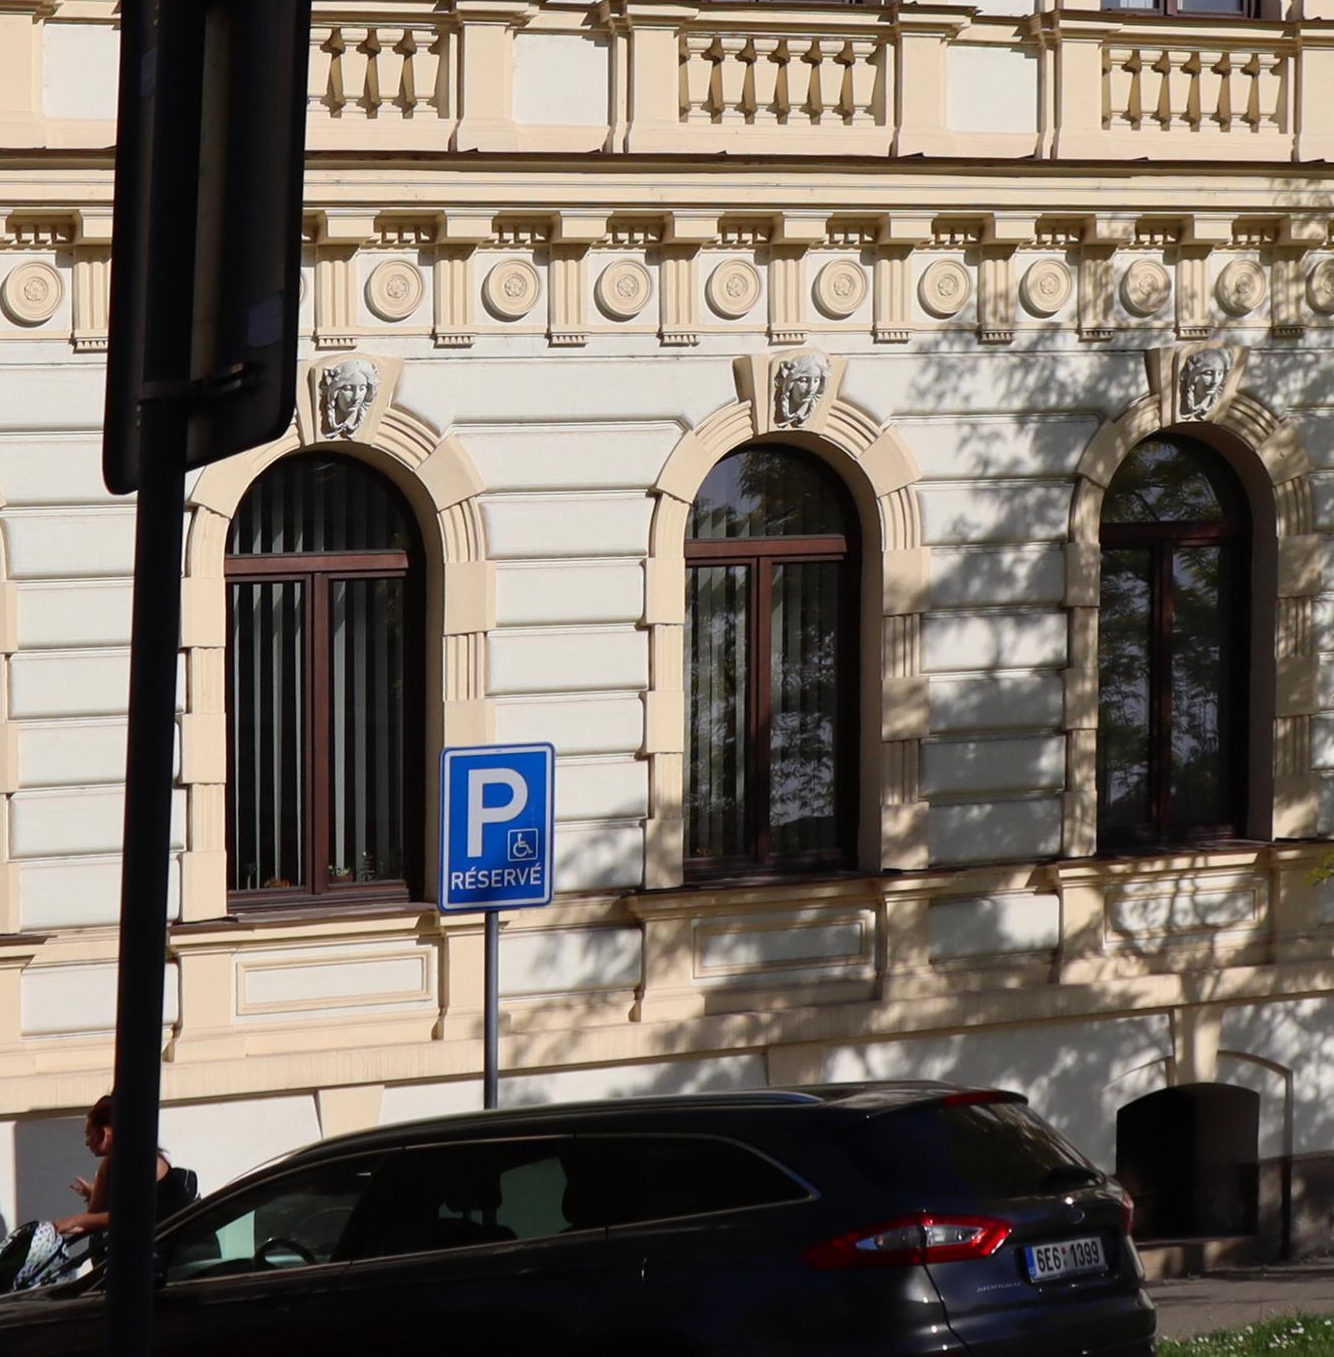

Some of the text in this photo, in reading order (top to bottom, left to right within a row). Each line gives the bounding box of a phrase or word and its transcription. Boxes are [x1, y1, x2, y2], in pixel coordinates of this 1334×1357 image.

[467, 767, 528, 858] P
[451, 862, 542, 890] RÉSERVÉ
[1036, 1240, 1100, 1272] 6E6 1399
